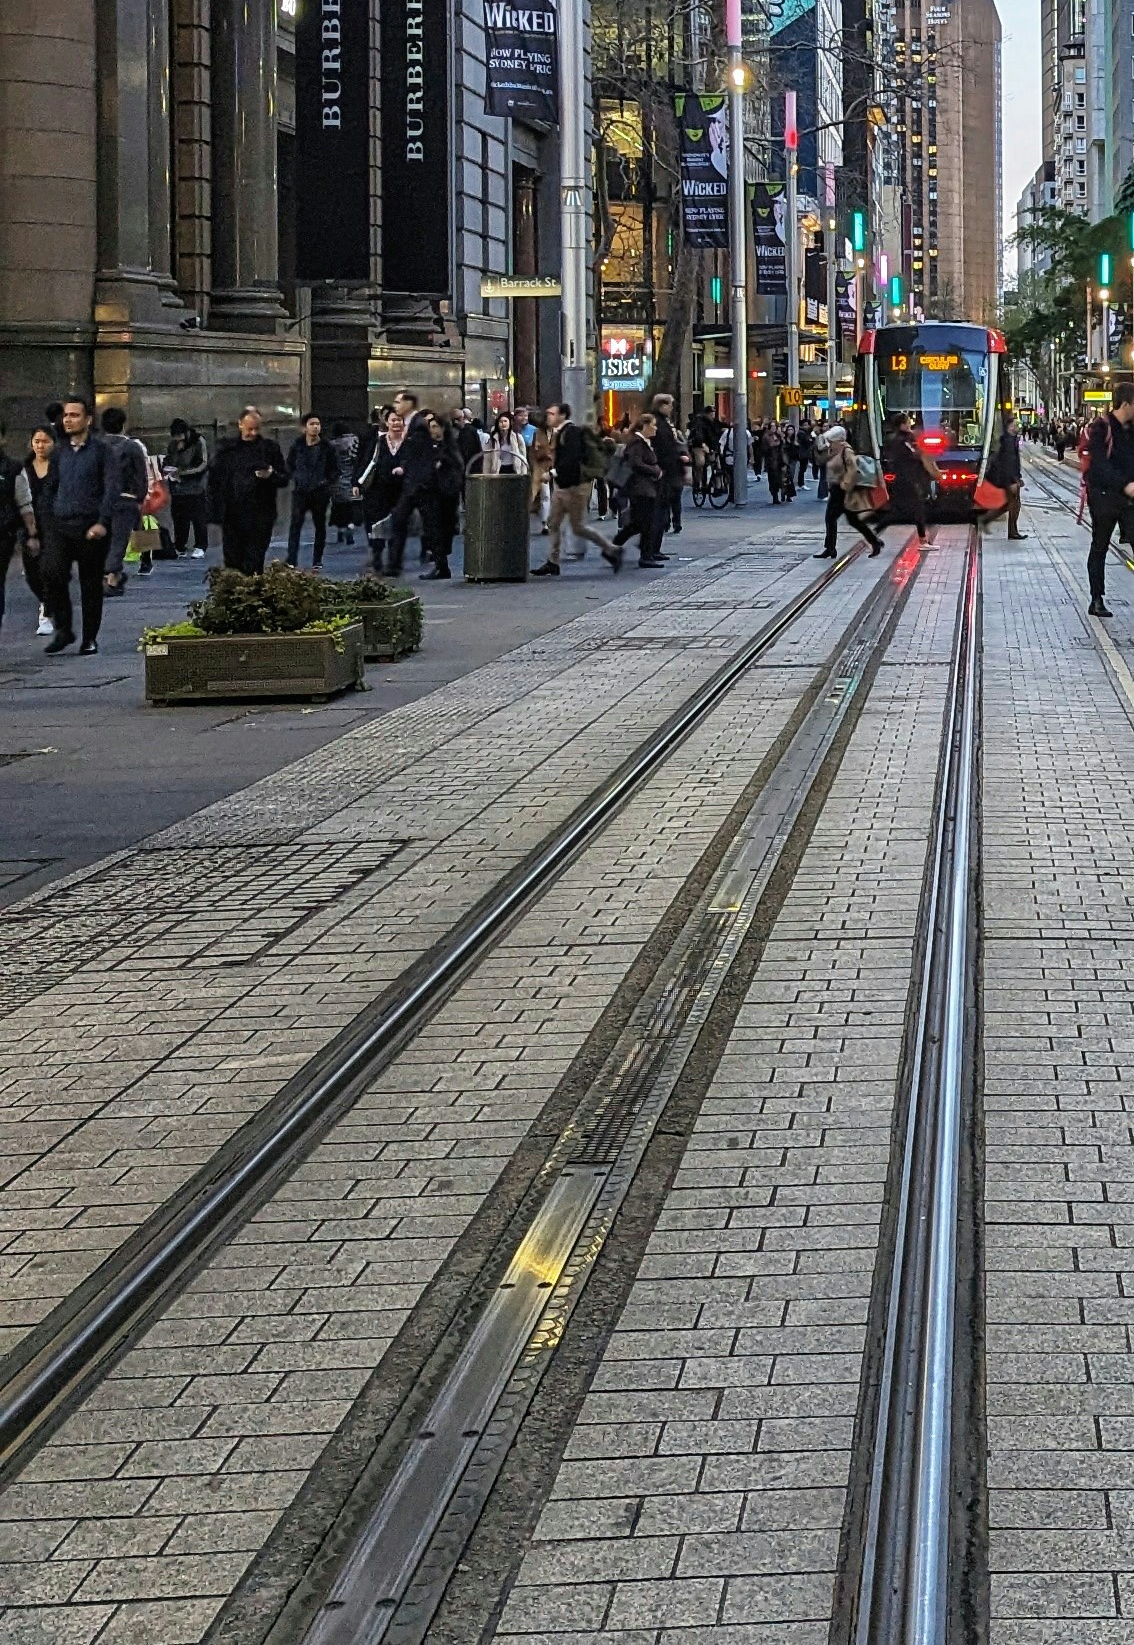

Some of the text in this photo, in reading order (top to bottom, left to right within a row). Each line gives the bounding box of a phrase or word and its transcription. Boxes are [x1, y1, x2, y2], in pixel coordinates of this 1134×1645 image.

[488, 58, 528, 70] SYDNEY
[501, 277, 557, 289] Barrack St
[891, 356, 907, 371] L3
[787, 390, 801, 404] 10
